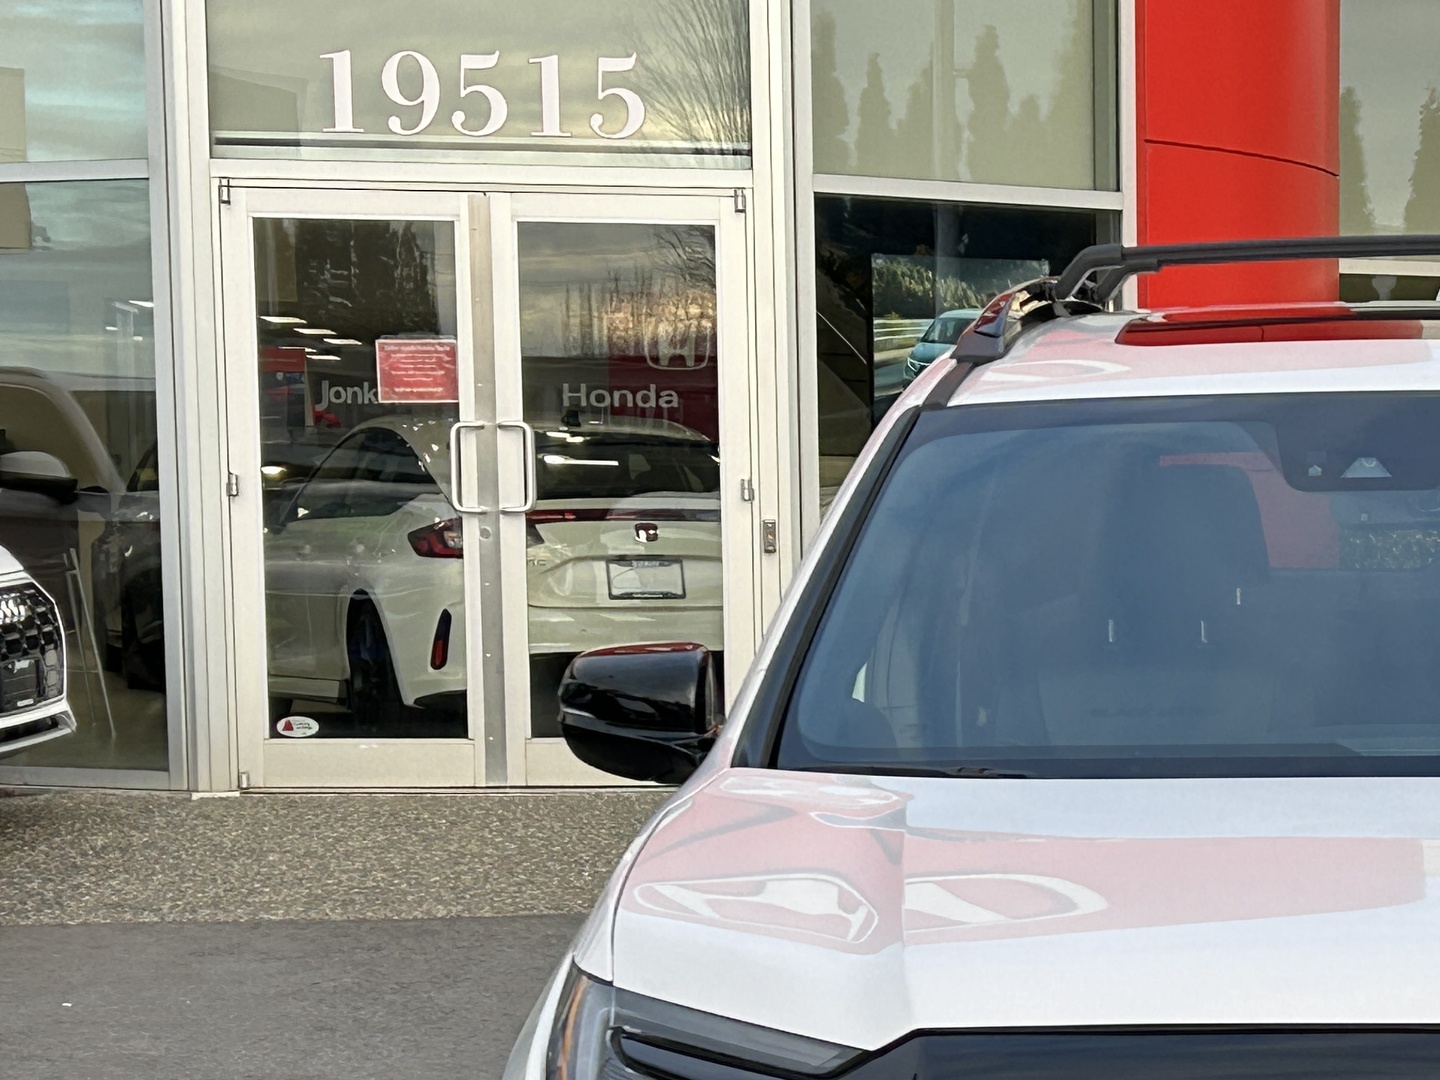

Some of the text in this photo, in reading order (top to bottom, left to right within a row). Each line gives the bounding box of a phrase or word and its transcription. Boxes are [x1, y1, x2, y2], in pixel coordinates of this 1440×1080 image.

[319, 49, 646, 140] 19515
[314, 380, 680, 412] Jonk Honda
